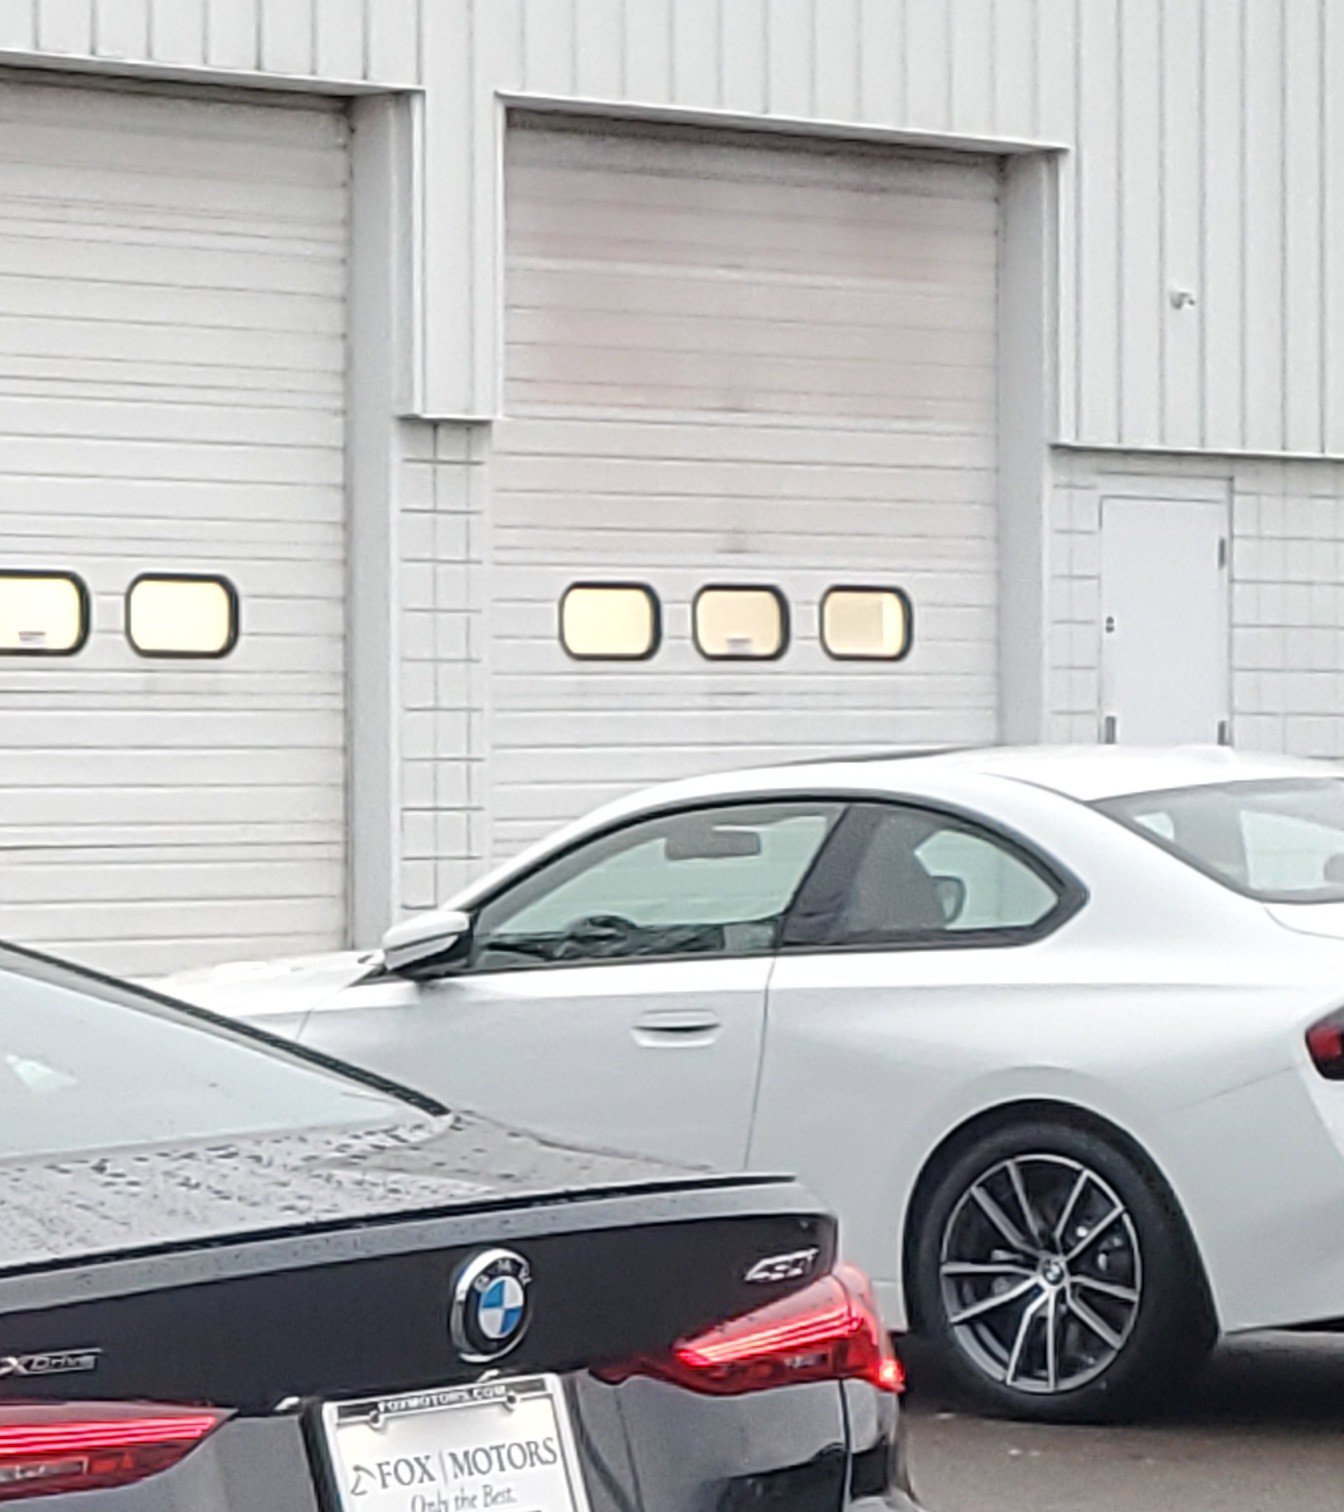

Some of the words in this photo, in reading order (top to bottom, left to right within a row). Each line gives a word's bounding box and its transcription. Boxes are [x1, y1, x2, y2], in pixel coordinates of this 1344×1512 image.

[377, 1455, 436, 1490] FOX
[451, 1437, 558, 1480] MOTORS
[454, 1486, 477, 1511] the
